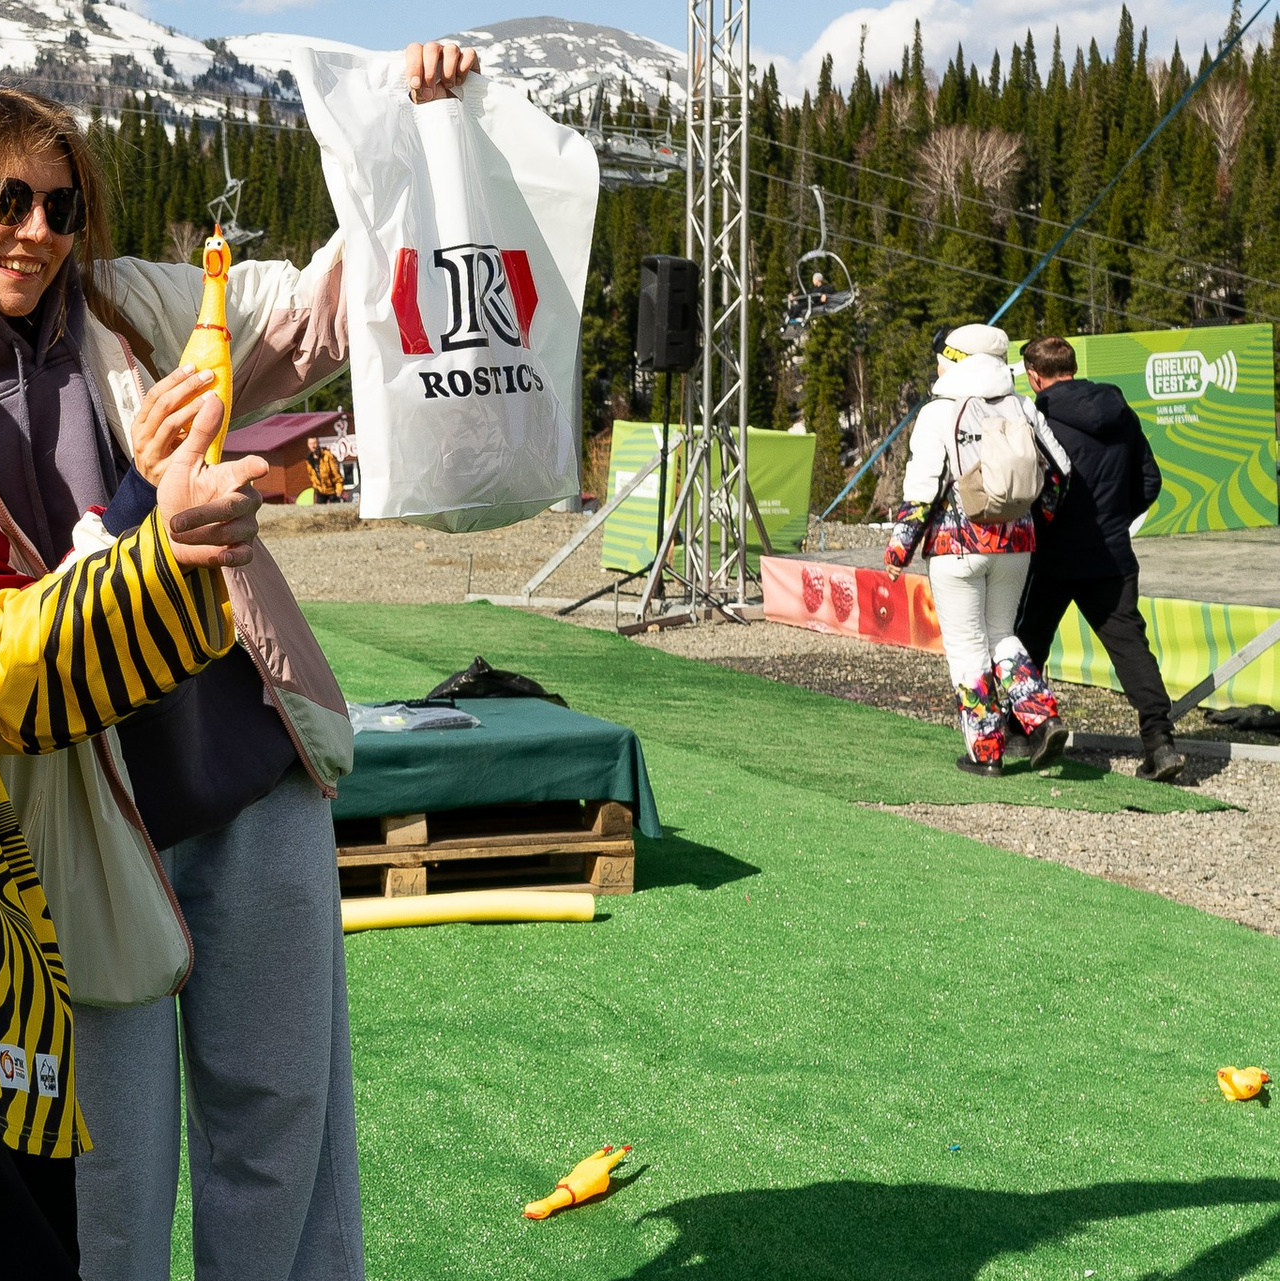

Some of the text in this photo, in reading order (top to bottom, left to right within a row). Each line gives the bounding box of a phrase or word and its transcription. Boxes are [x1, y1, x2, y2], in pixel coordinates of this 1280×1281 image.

[434, 243, 520, 352] R
[1154, 357, 1199, 376] GRELKA
[418, 364, 544, 399] ROSTIC'S
[1154, 374, 1185, 393] FEST
